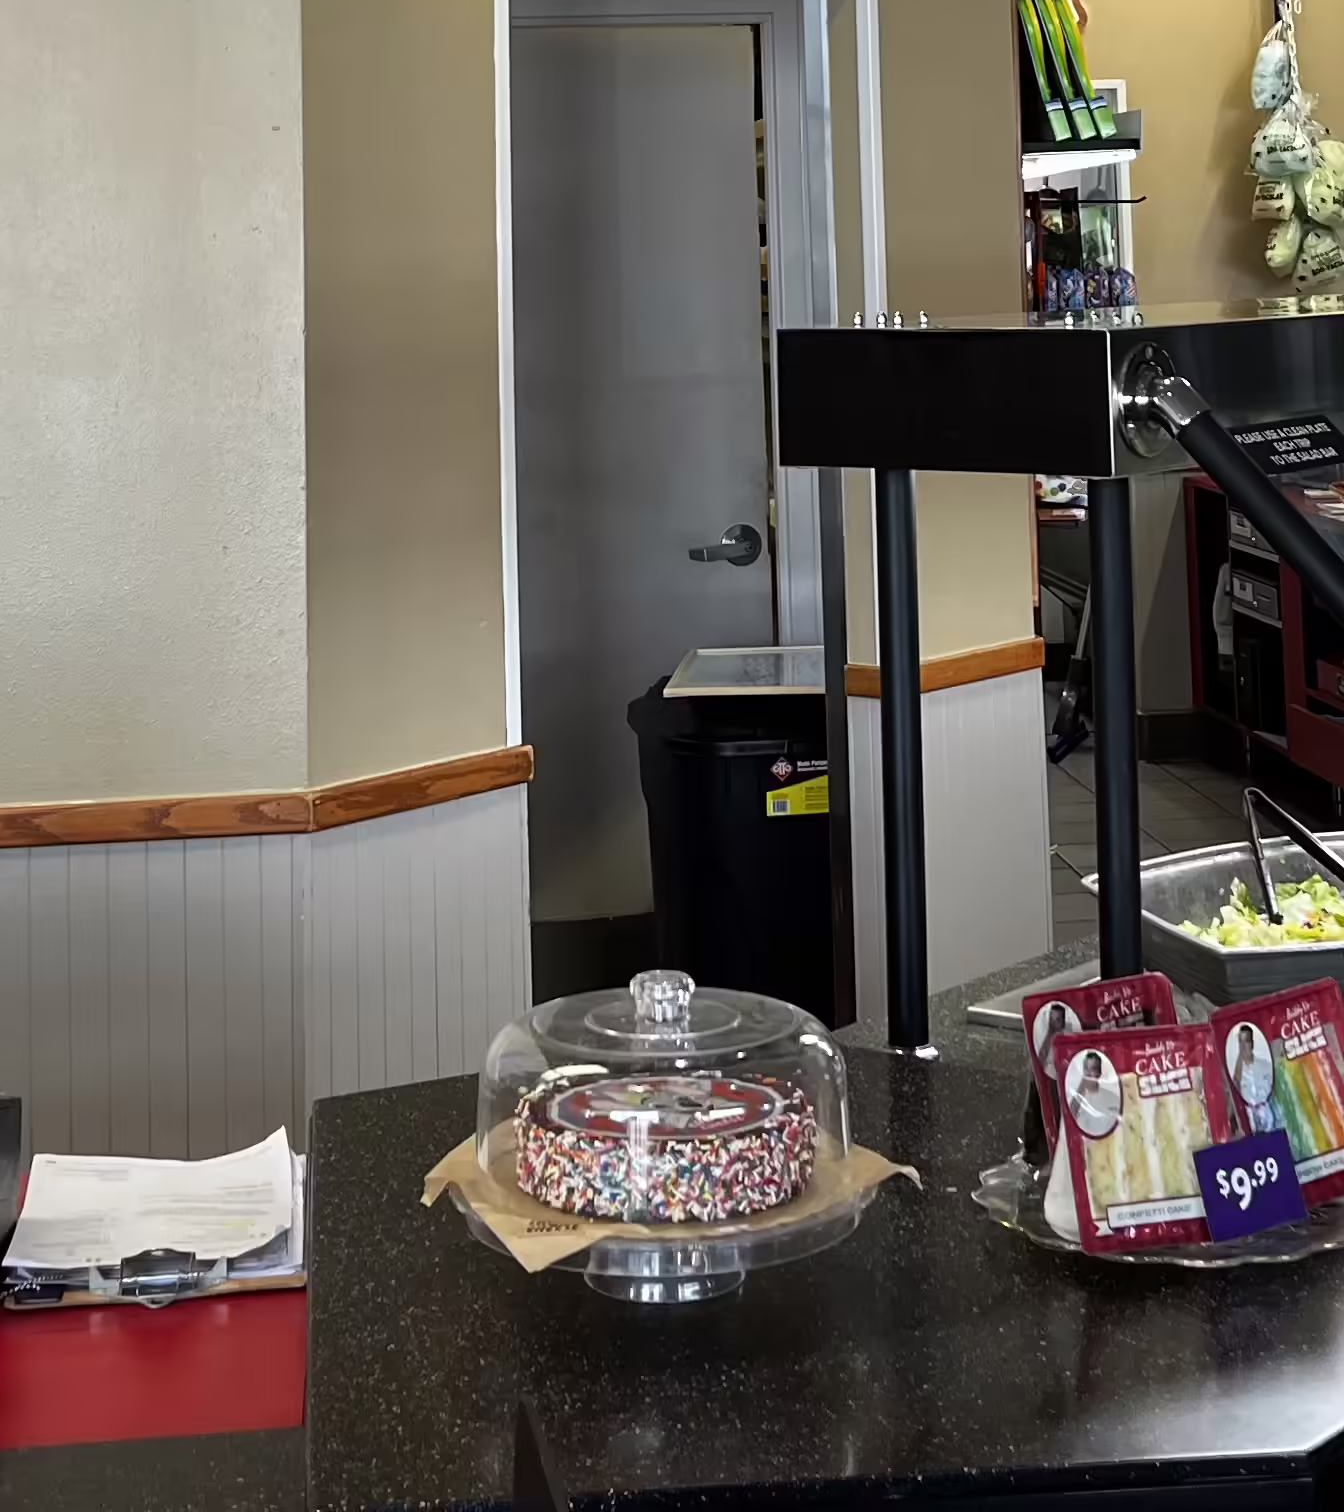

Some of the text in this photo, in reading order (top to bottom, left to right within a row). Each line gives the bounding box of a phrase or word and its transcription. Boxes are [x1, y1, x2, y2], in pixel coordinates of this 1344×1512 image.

[1097, 996, 1142, 1022] CAKE
[1281, 1010, 1321, 1040] CAKE
[1135, 1051, 1187, 1076] CAKE
[1215, 1156, 1279, 1212] $9.99
